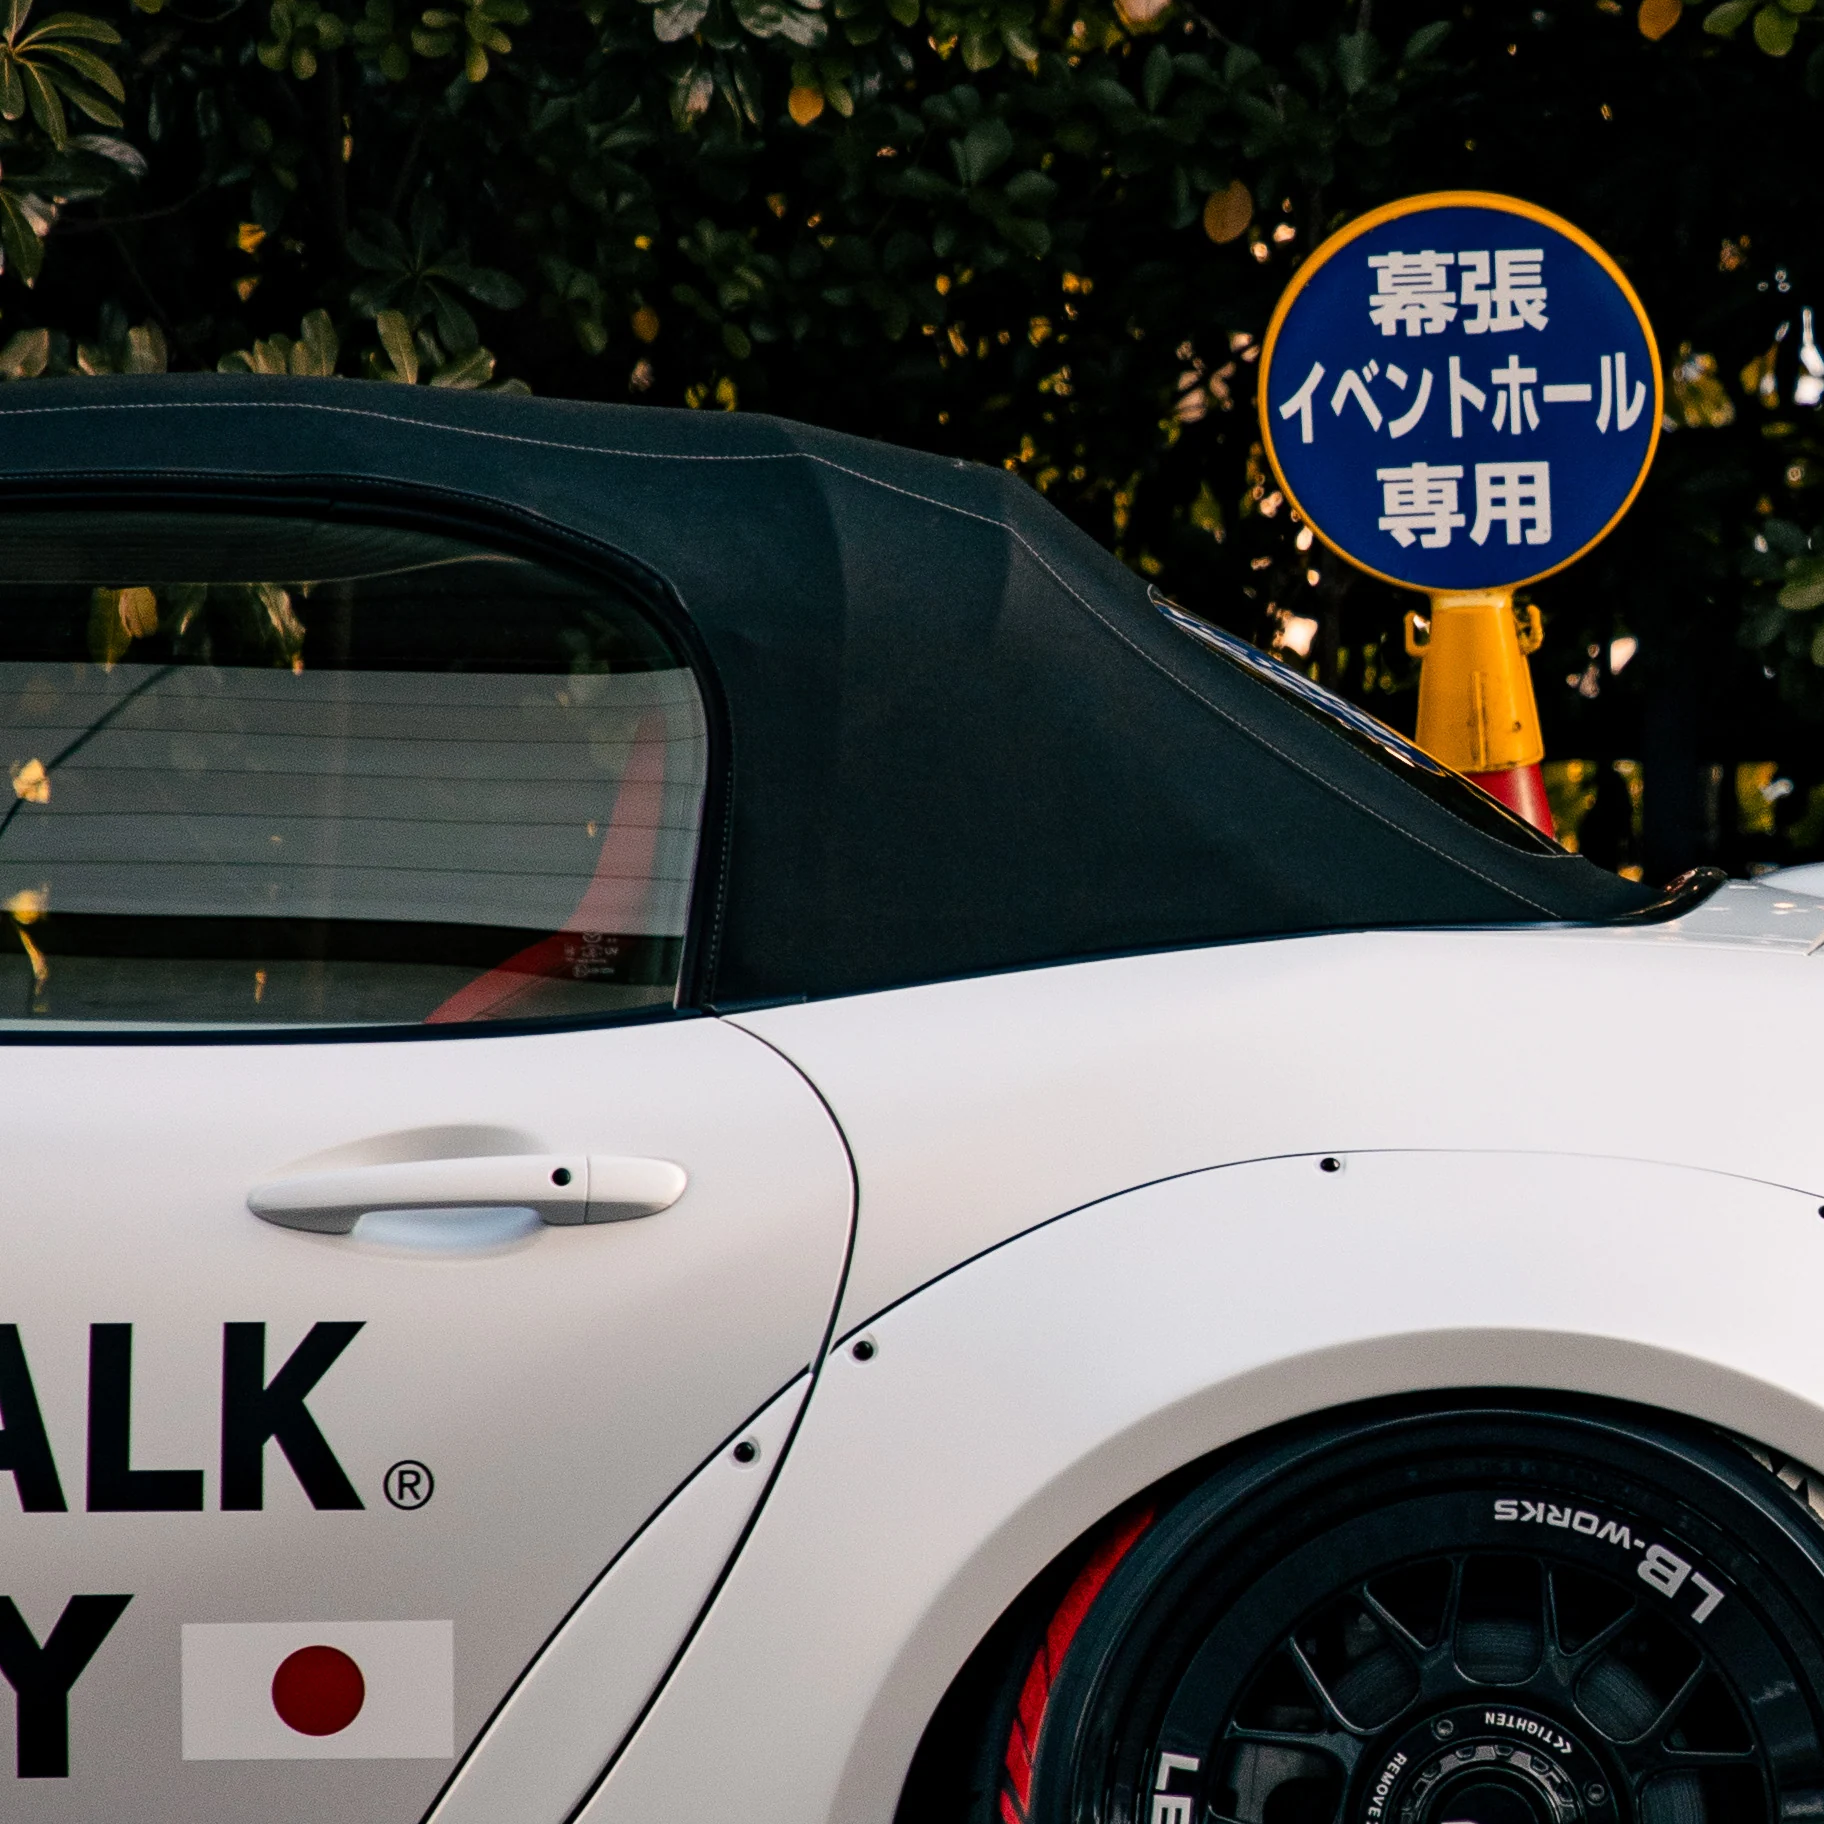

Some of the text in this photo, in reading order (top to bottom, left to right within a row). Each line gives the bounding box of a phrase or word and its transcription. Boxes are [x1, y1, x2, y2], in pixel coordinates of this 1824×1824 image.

[1368, 249, 1549, 336] 幕張
[1279, 352, 1646, 444] イベントホール
[1376, 461, 1552, 549] 専用
[1494, 1499, 1725, 1624] LB-WORKS
[1485, 1711, 1560, 1745] TIGHTEN
[1367, 1752, 1408, 1818] REMOVE
